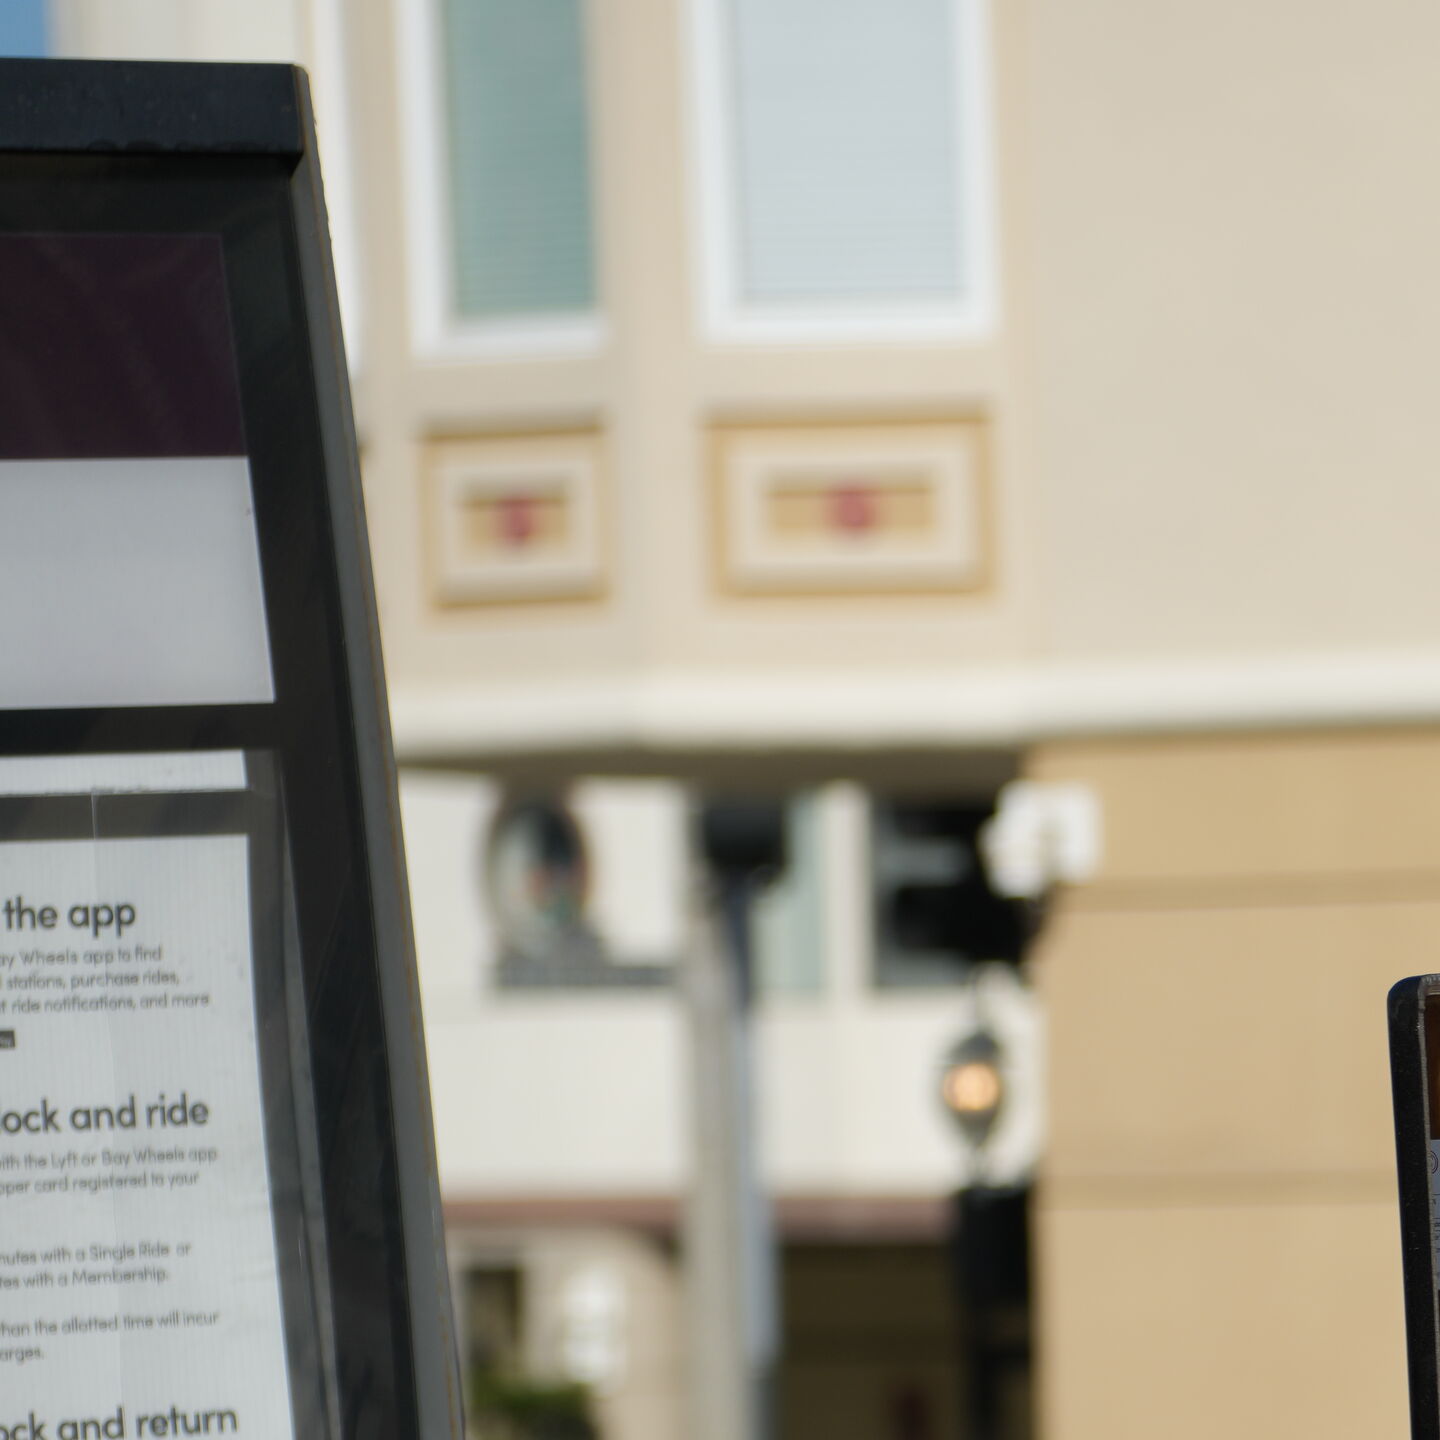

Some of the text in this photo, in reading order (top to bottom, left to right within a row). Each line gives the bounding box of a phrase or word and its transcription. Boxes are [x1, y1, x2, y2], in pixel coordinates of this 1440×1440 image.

[2, 895, 136, 937] the app
[21, 945, 163, 967] Wheels app to find
[7, 974, 66, 991] stations,
[71, 971, 140, 991] purchase
[142, 968, 180, 985] rides,
[11, 997, 41, 1014] ride
[44, 995, 137, 1013] notifications,
[140, 992, 168, 1009] and
[172, 993, 210, 1009] more
[70, 1094, 137, 1131] and
[146, 1090, 209, 1127] ride
[24, 1146, 218, 1171] the Lyft or Bay Wheels app
[34, 1171, 200, 1195] card registered to your
[40, 1247, 71, 1265] with
[75, 1249, 86, 1262] a
[89, 1243, 136, 1264] Single
[22, 1270, 54, 1288] with
[57, 1273, 69, 1287] a
[34, 1308, 220, 1335] the allotted time will incur
[136, 1404, 240, 1440] return
